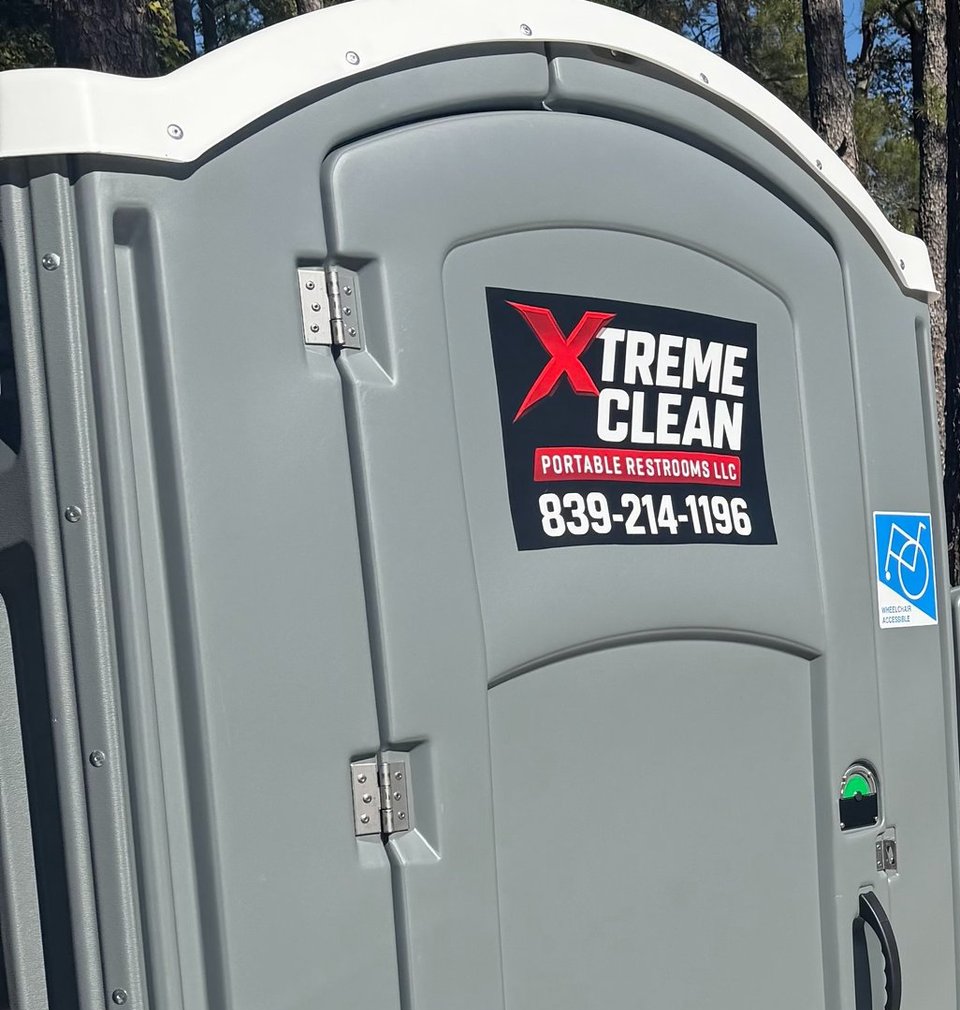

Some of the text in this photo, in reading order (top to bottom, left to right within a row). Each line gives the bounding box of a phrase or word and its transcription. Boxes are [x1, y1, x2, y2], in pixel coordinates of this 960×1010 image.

[505, 300, 748, 424] XTREME
[597, 388, 744, 451] CLEAN
[541, 454, 738, 481] PORTABLE RESTROOMS LLC
[538, 491, 752, 537] 839-214-1196
[881, 605, 912, 614] WHEELCHAIR
